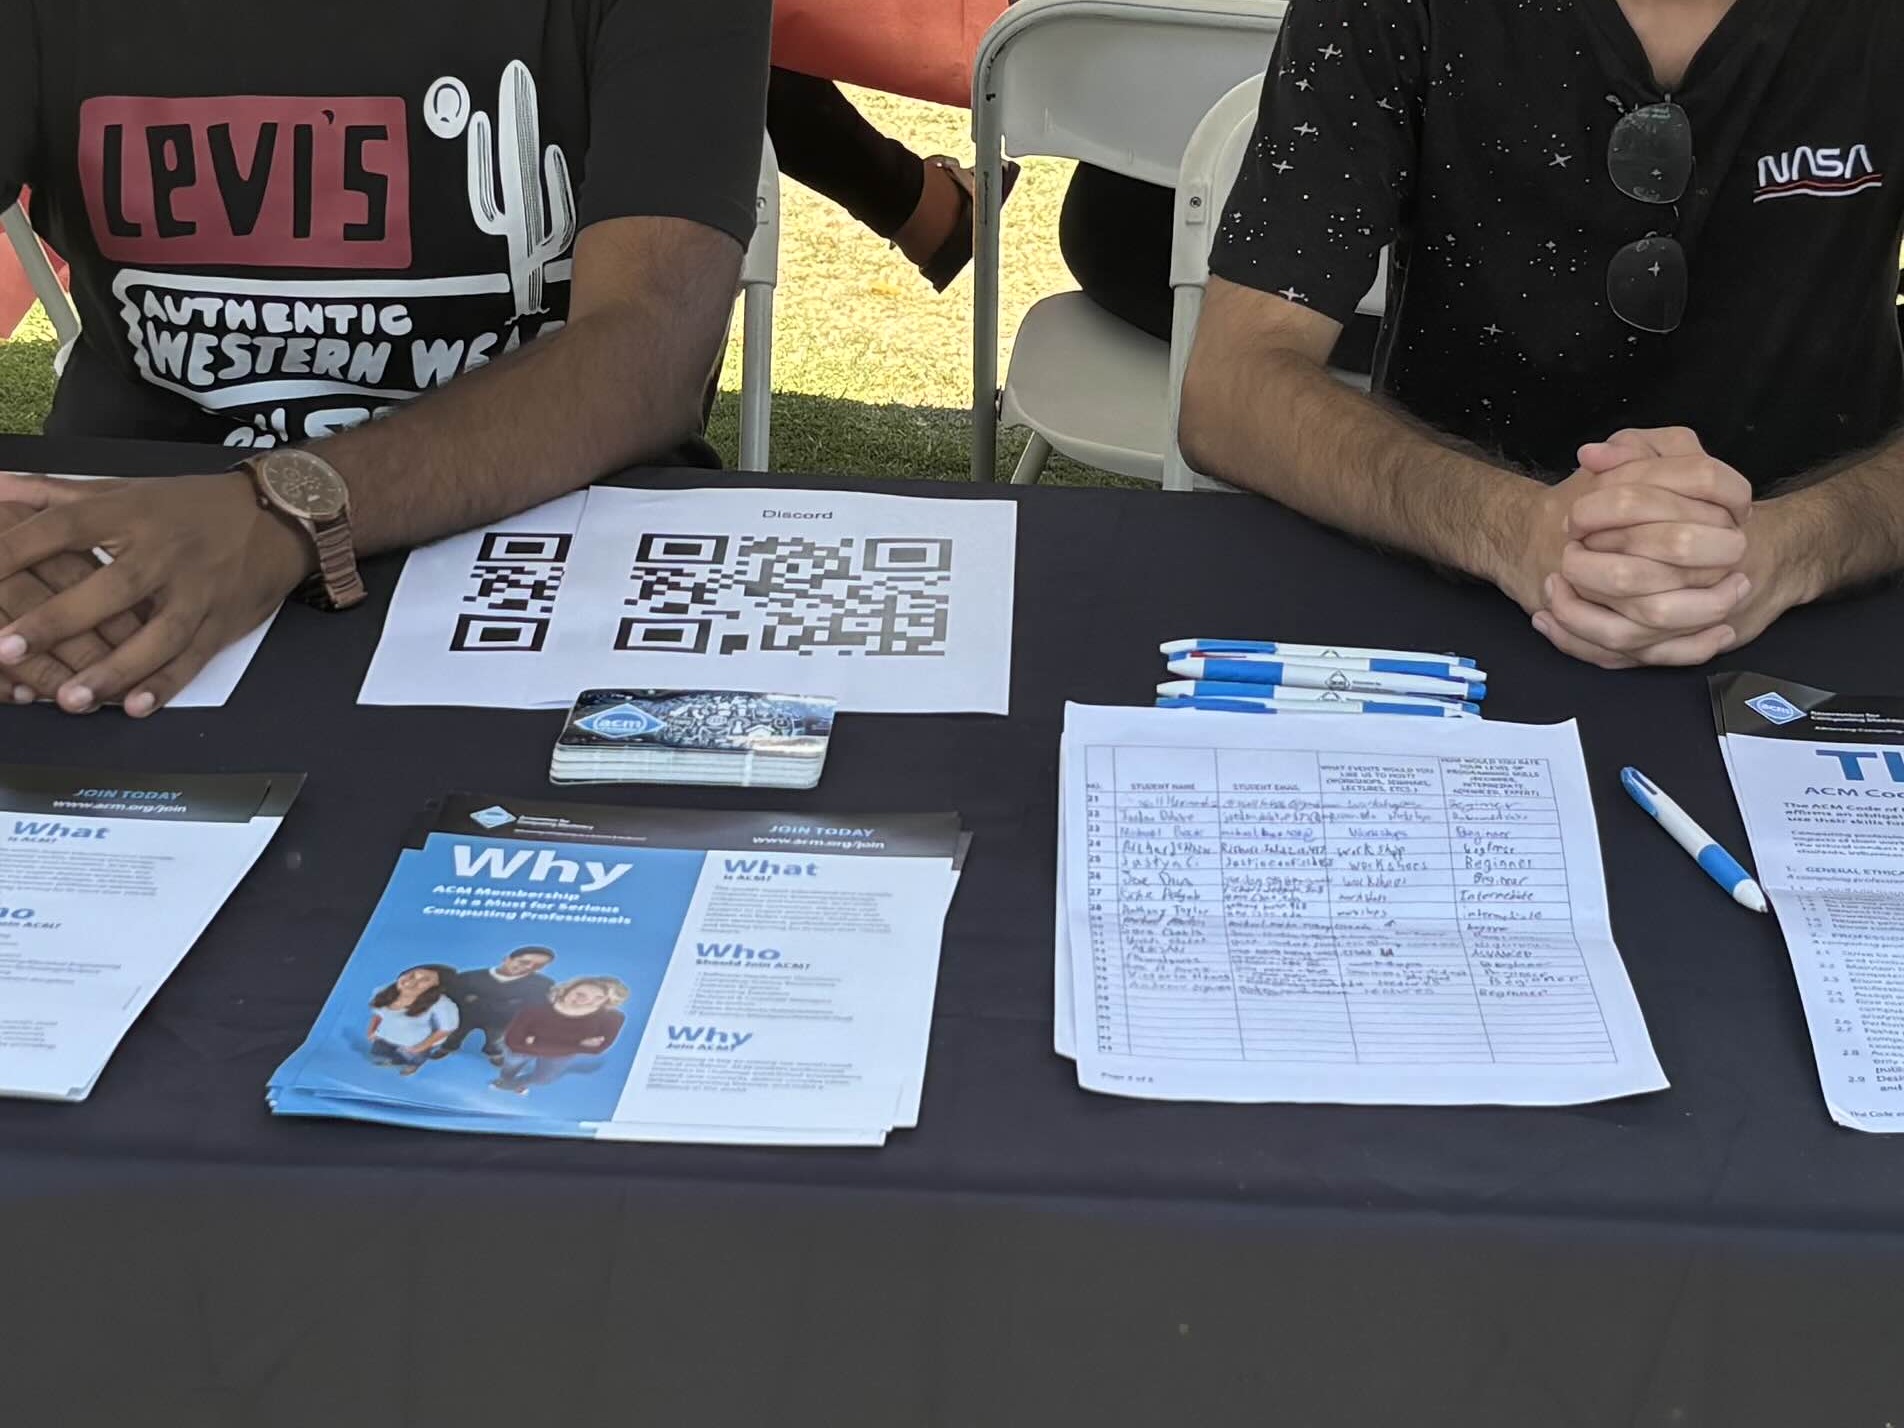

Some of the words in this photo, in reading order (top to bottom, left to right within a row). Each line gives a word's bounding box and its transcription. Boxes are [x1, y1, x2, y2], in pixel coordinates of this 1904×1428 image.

[1757, 143, 1874, 188] NASA
[143, 289, 413, 336] AUTHENTIC
[145, 320, 393, 387] WESTERN
[761, 508, 834, 520] Discord
[73, 788, 119, 800] JOIN
[120, 789, 183, 802] TODAY
[1803, 785, 1860, 798] ACM
[12, 820, 112, 841] What
[768, 824, 812, 836] JOIN
[814, 826, 876, 838] TODAY
[453, 844, 634, 893] Why
[723, 858, 820, 877] What
[431, 884, 471, 896] ACM
[474, 885, 581, 902] Membership
[422, 905, 519, 921] Computing
[519, 910, 633, 925] Professionals
[695, 941, 782, 961] Who
[667, 1025, 753, 1047] Why
